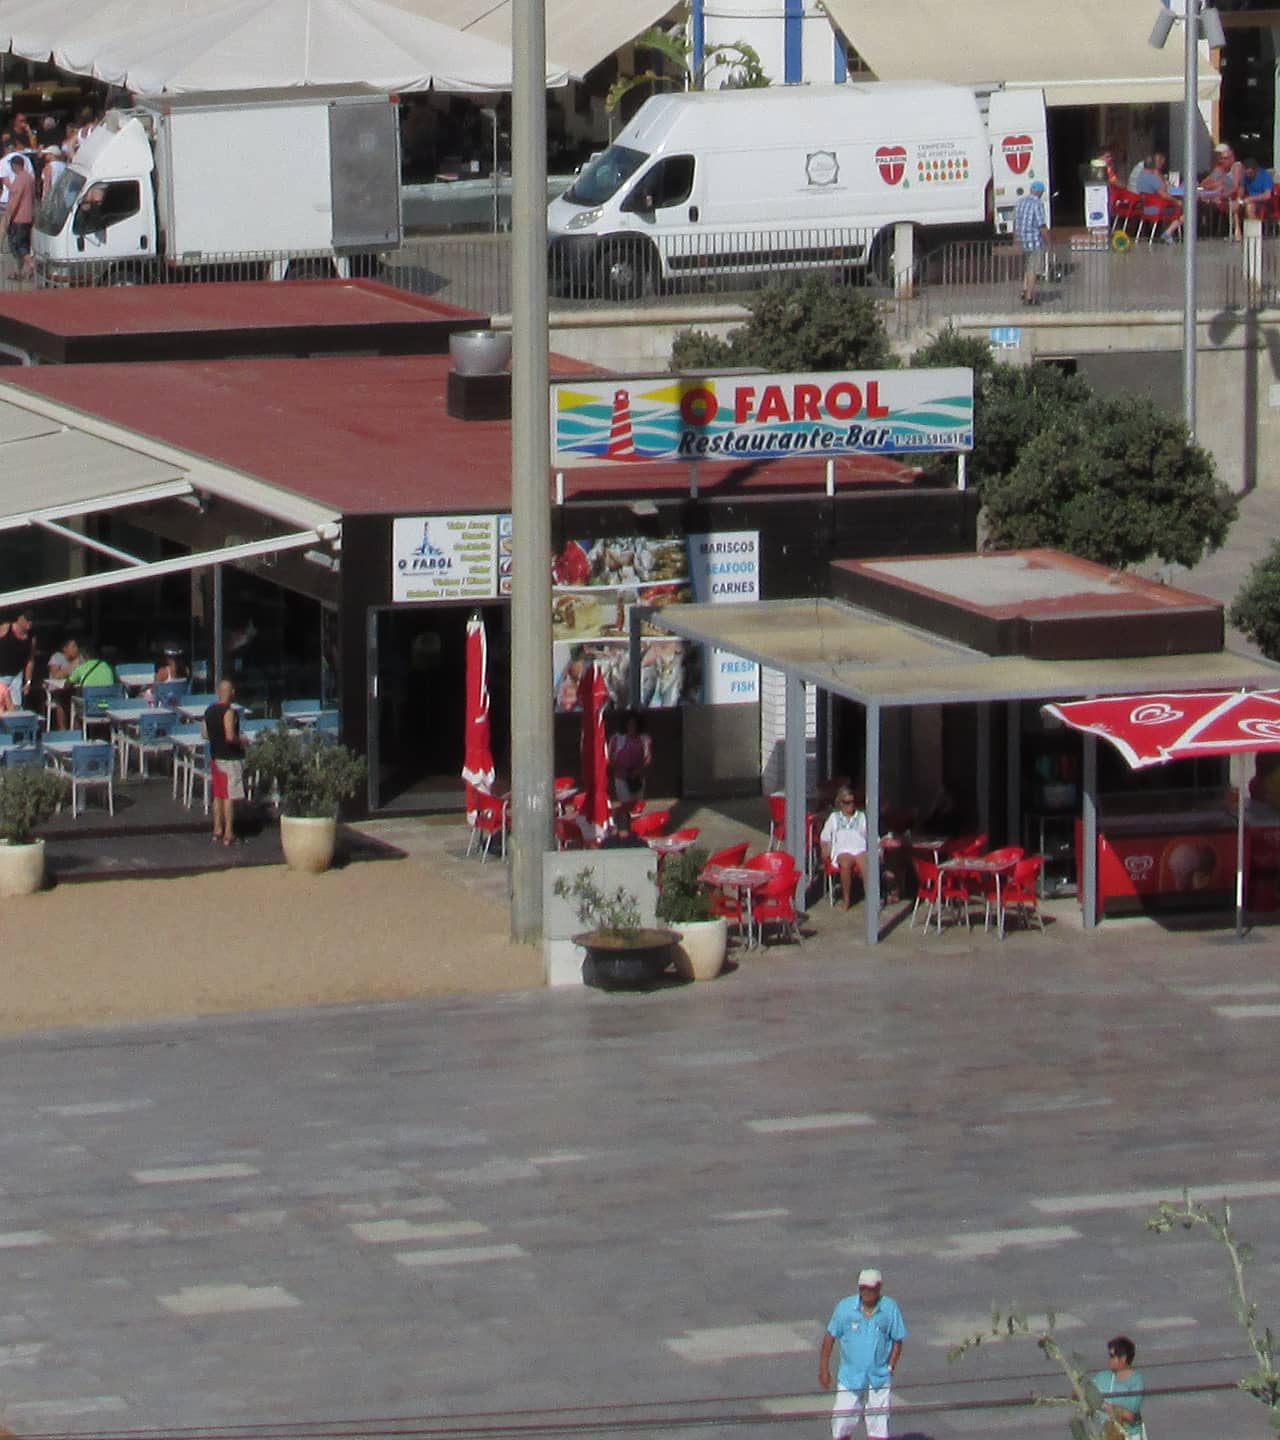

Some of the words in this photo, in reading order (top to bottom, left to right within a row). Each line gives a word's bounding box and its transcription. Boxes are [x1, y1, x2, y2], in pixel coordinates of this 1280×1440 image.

[680, 388, 718, 426] O
[735, 380, 889, 425] FAROL
[678, 425, 890, 454] Restaurante-Bar
[700, 541, 754, 554] MARISCOS
[398, 560, 407, 570] O
[413, 558, 453, 569] FAROL
[705, 562, 754, 576] SEAFOOD
[712, 581, 754, 594] CARNES
[721, 661, 754, 673] FRESH
[731, 681, 754, 693] FISH
